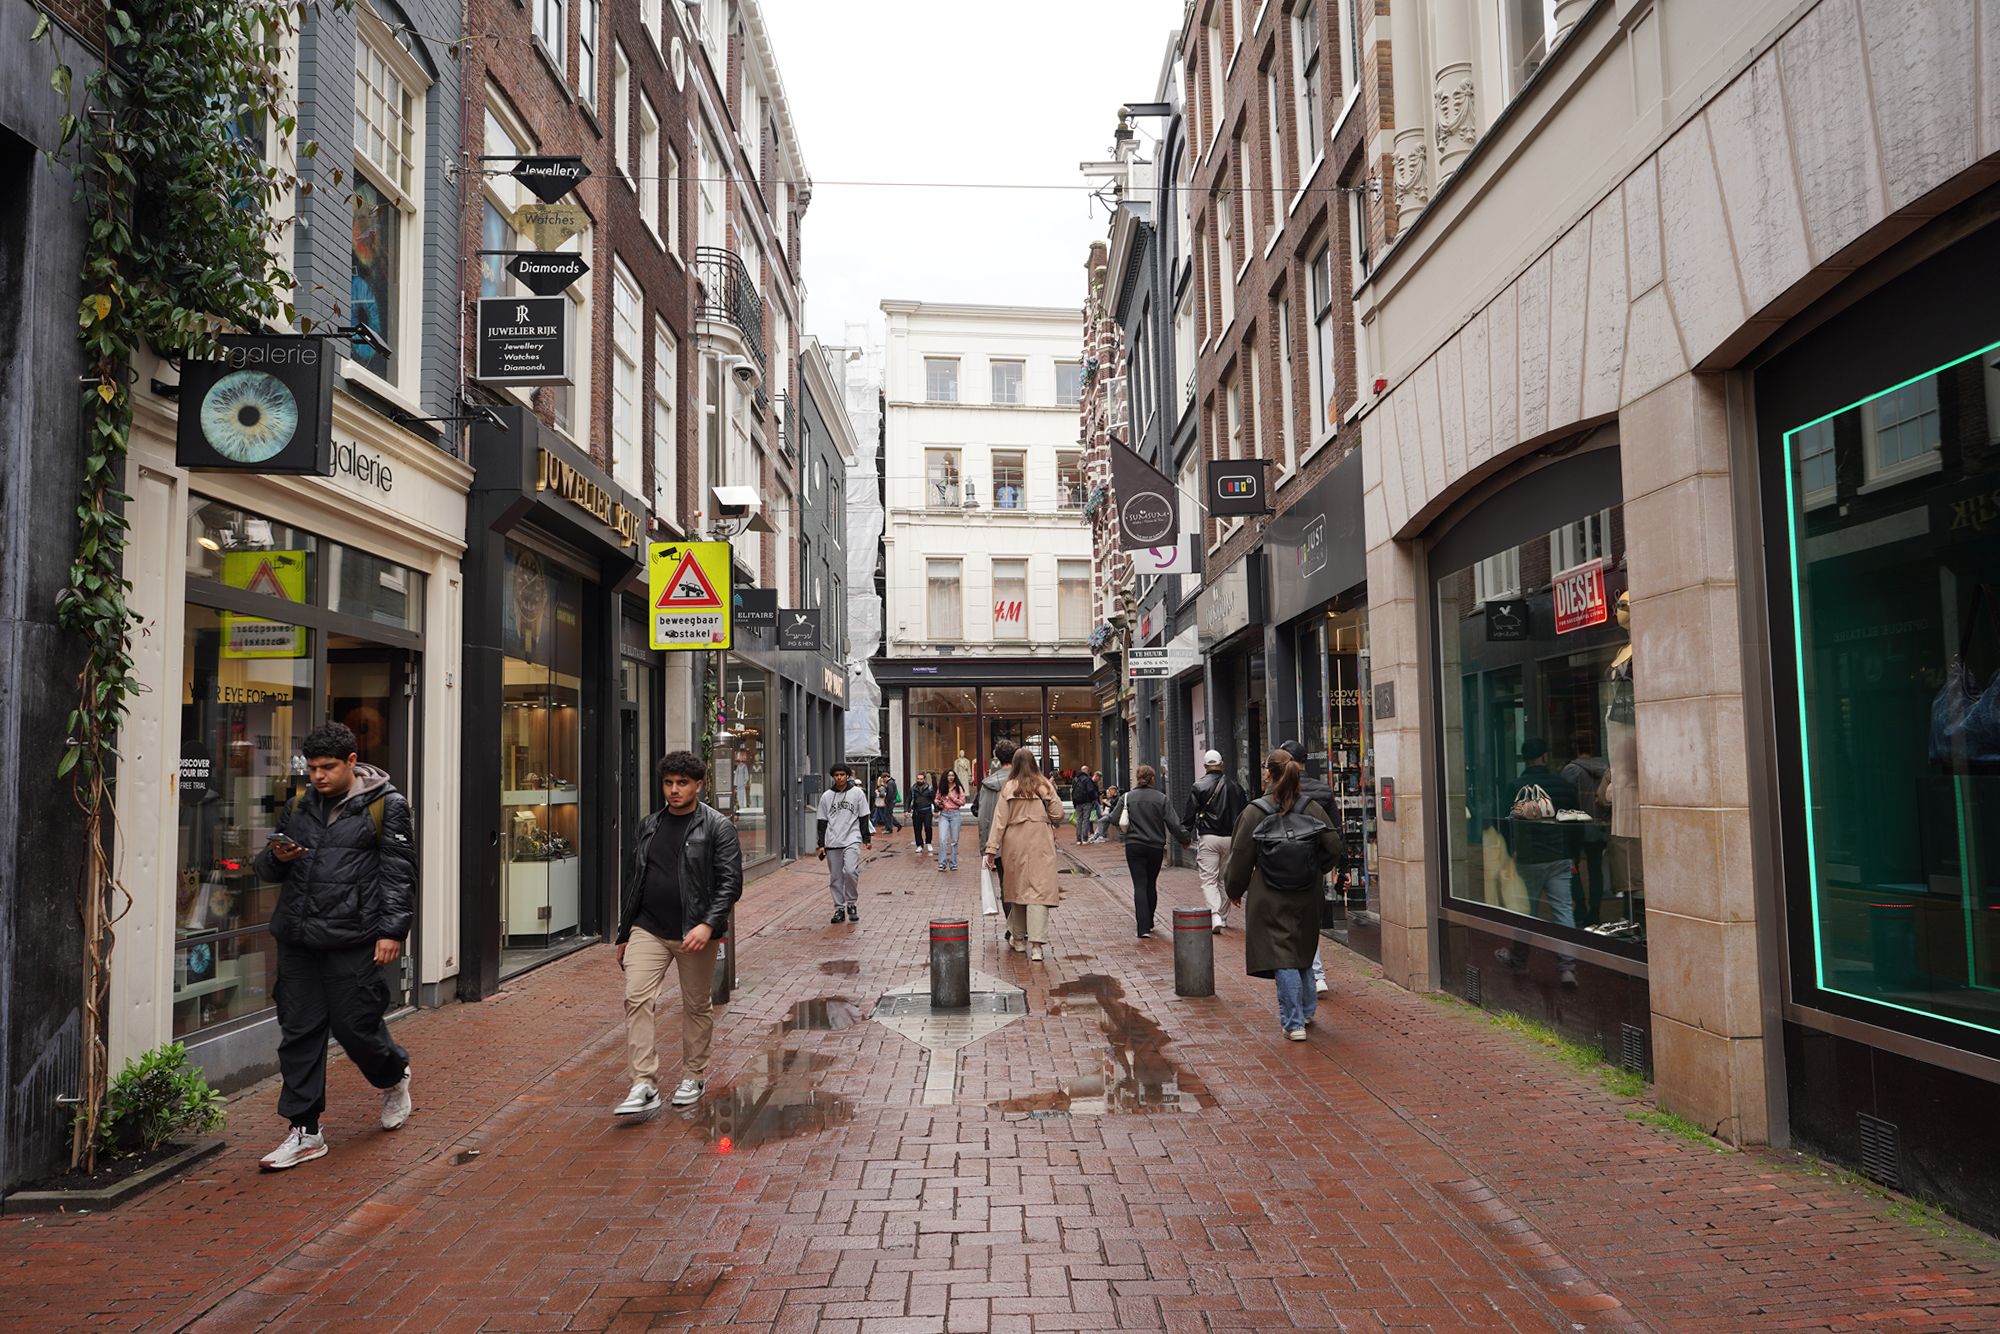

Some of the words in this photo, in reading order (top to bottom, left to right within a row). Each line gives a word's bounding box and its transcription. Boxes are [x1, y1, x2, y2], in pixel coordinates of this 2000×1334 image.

[522, 163, 580, 179] Jewellery
[524, 213, 575, 225] Watches
[519, 260, 580, 274] Diamonds
[487, 326, 536, 338] JUWELIER
[536, 325, 558, 337] RIJK
[503, 342, 544, 351] Jewellery
[503, 353, 540, 361] Watches
[503, 363, 546, 371] Diamonds
[536, 448, 613, 527] JUWELIER
[610, 502, 641, 549] RIJK
[1307, 524, 1324, 552] JUST
[1555, 570, 1602, 618] DIESEL
[993, 600, 1022, 623] H&M
[659, 616, 719, 627] beweegbaar
[665, 629, 710, 638] bstakel
[224, 686, 243, 702] EYE
[197, 769, 209, 777] IRIS
[180, 781, 192, 789] FREE
[193, 781, 206, 789] TRIAL
